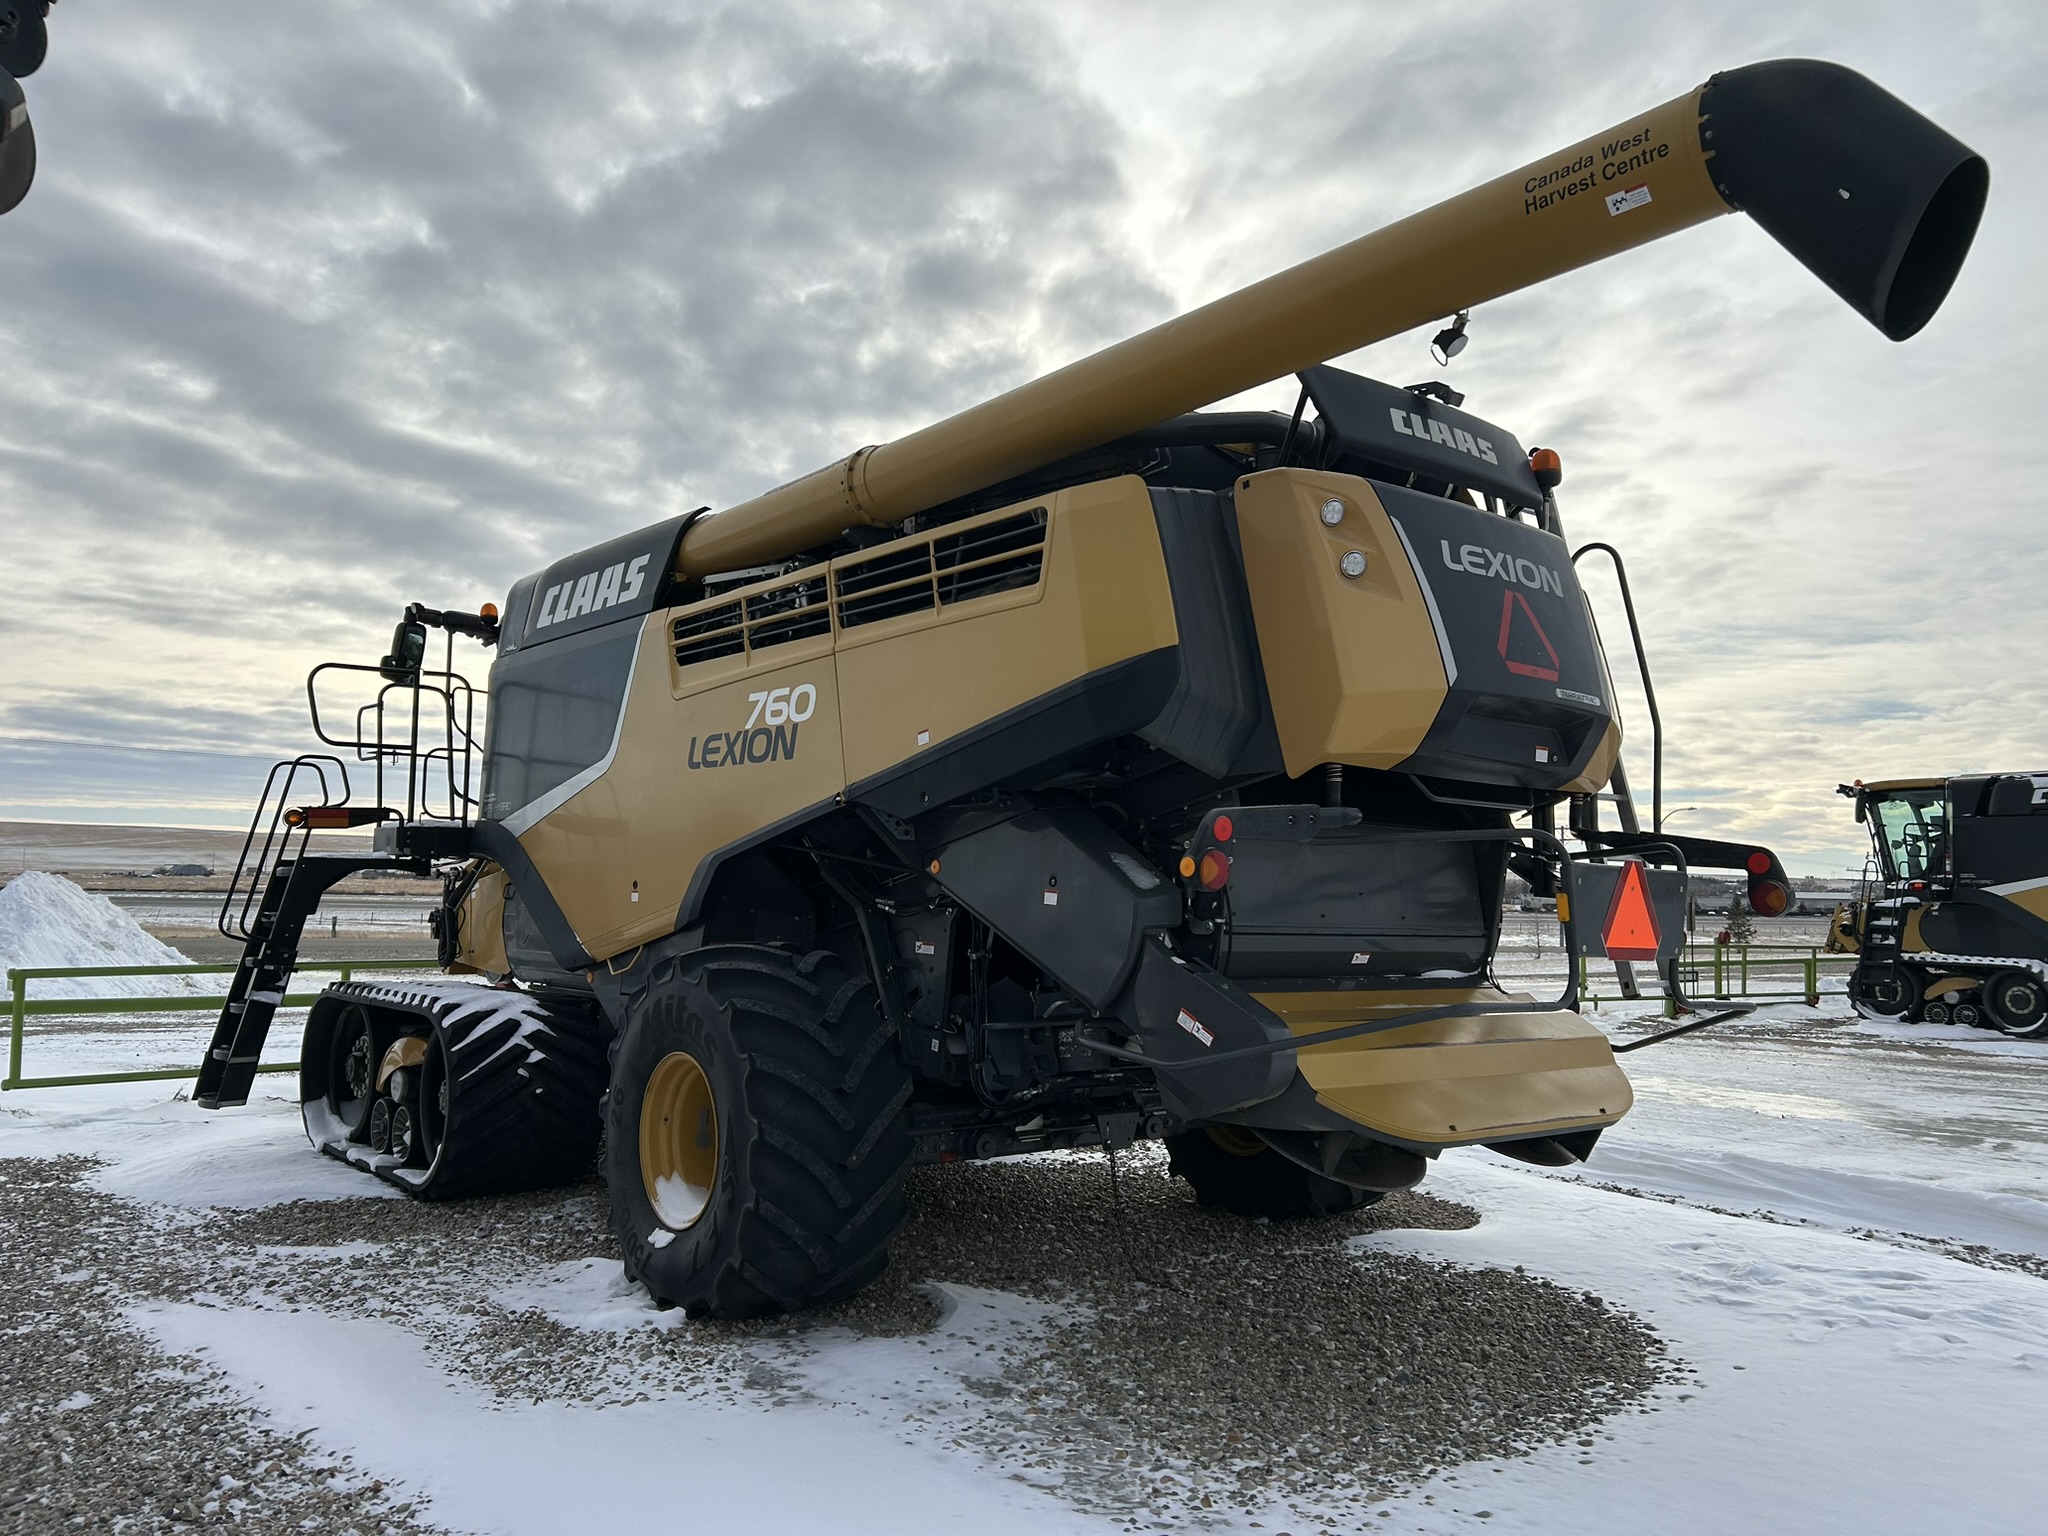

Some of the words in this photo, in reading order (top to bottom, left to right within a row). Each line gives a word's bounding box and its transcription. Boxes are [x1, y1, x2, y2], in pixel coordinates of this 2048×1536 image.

[1524, 154, 1594, 193] Canada
[1601, 127, 1651, 160] West
[1524, 172, 1597, 215] Harvest
[1602, 143, 1669, 181] Centre
[1389, 407, 1498, 465] CLAAS
[536, 553, 651, 629] CLAAS
[1440, 539, 1564, 598] LEXION
[744, 683, 817, 729] 760
[688, 723, 798, 769] LEXION
